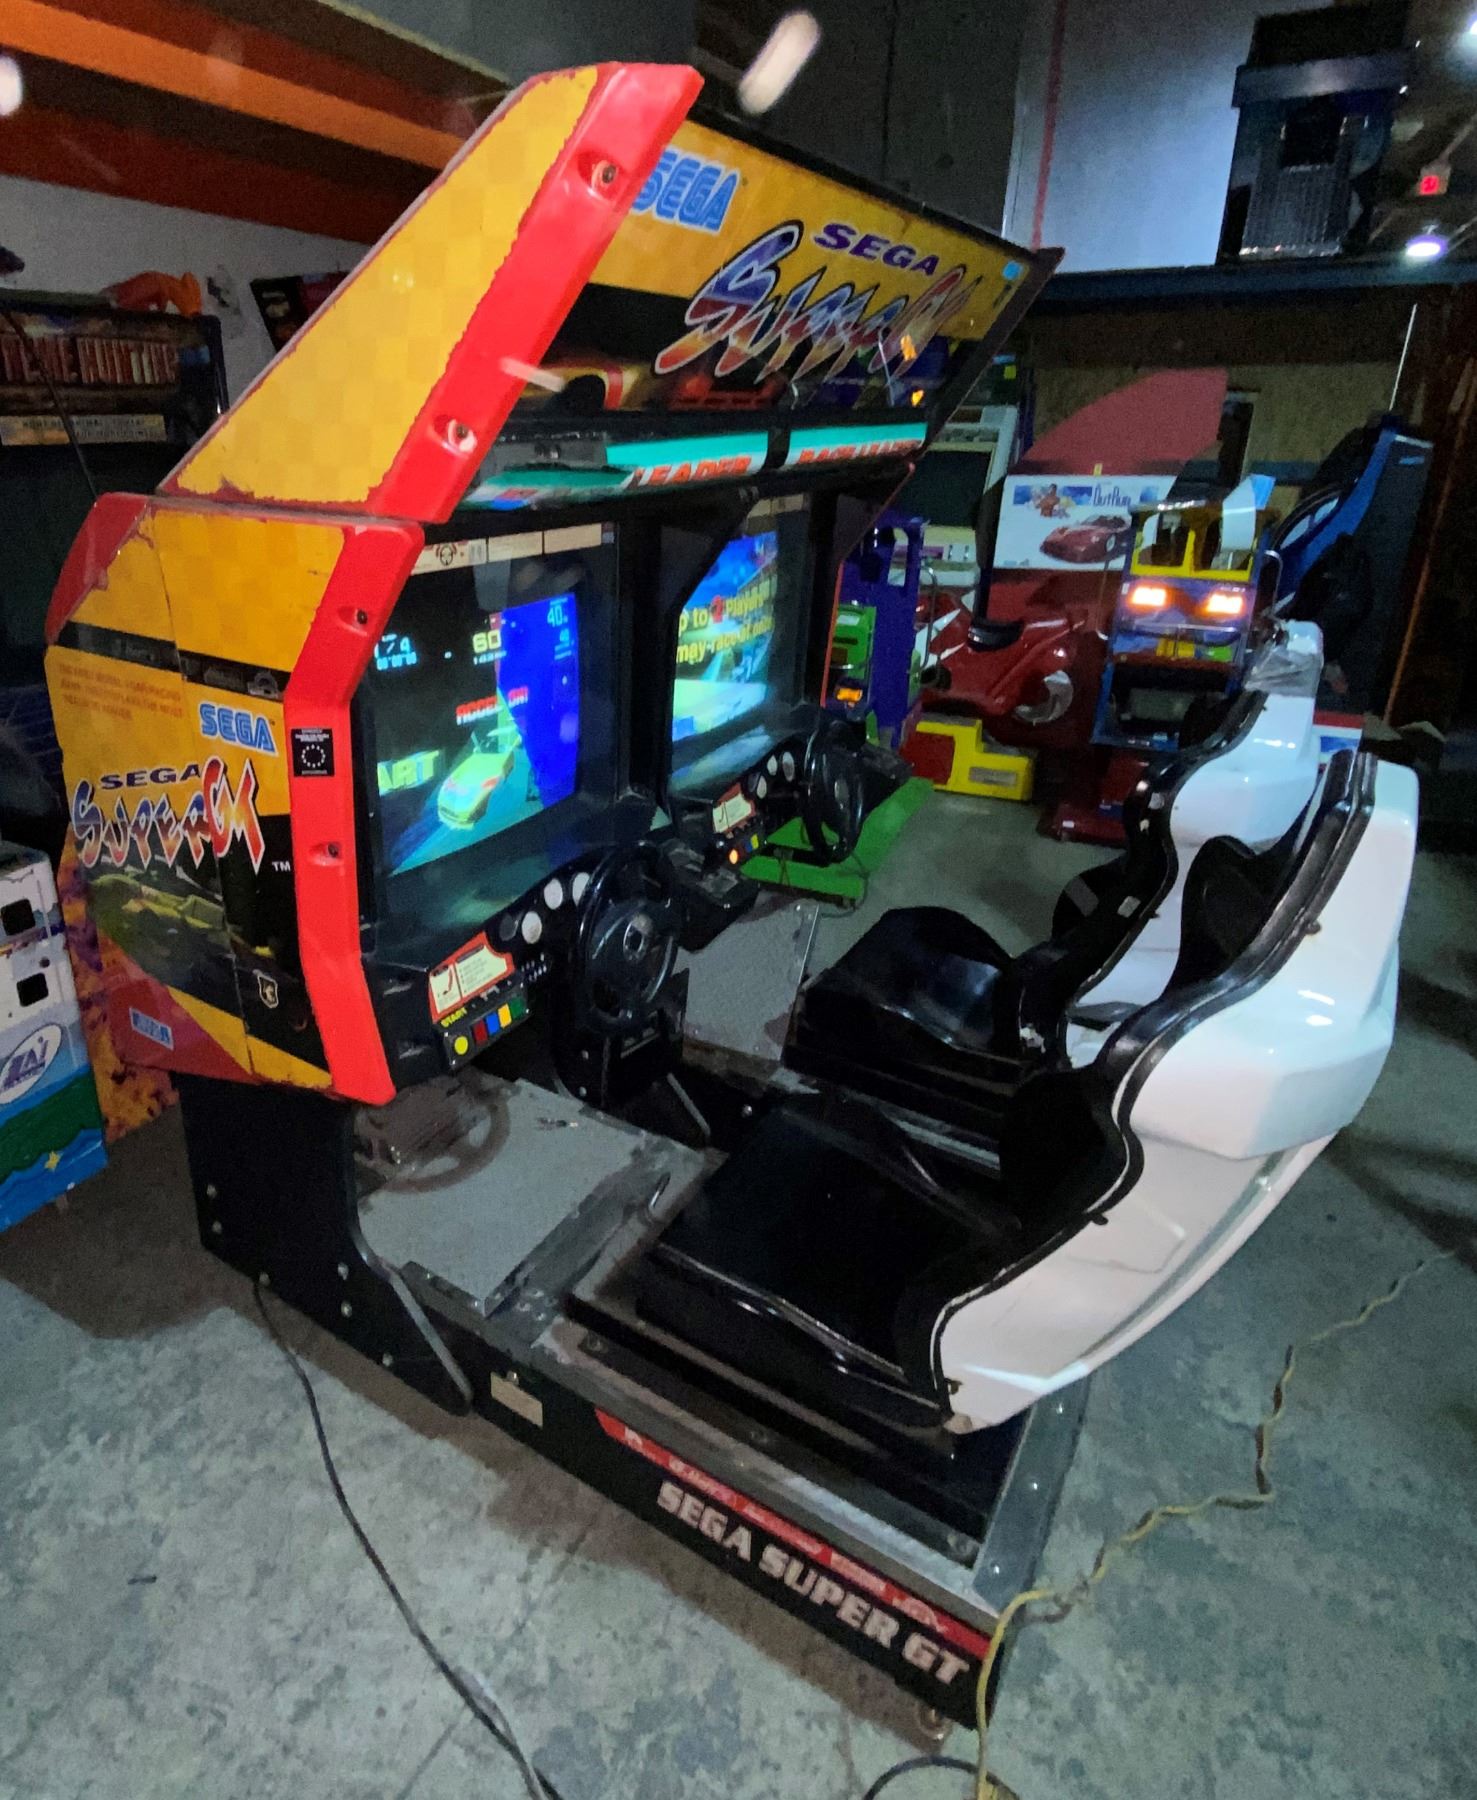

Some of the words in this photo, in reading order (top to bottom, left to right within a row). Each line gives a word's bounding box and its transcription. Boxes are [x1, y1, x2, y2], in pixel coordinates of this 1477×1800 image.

[631, 149, 739, 232] SEGA
[813, 222, 940, 276] SEGA
[472, 629, 502, 653] 60
[692, 607, 708, 628] to
[676, 640, 706, 665] may
[199, 704, 276, 755] SEGA
[101, 763, 203, 789] SEGA
[377, 750, 439, 797] ART
[656, 1480, 752, 1562] SEGA
[758, 1547, 900, 1650] SUPER
[902, 1631, 970, 1686] GT
